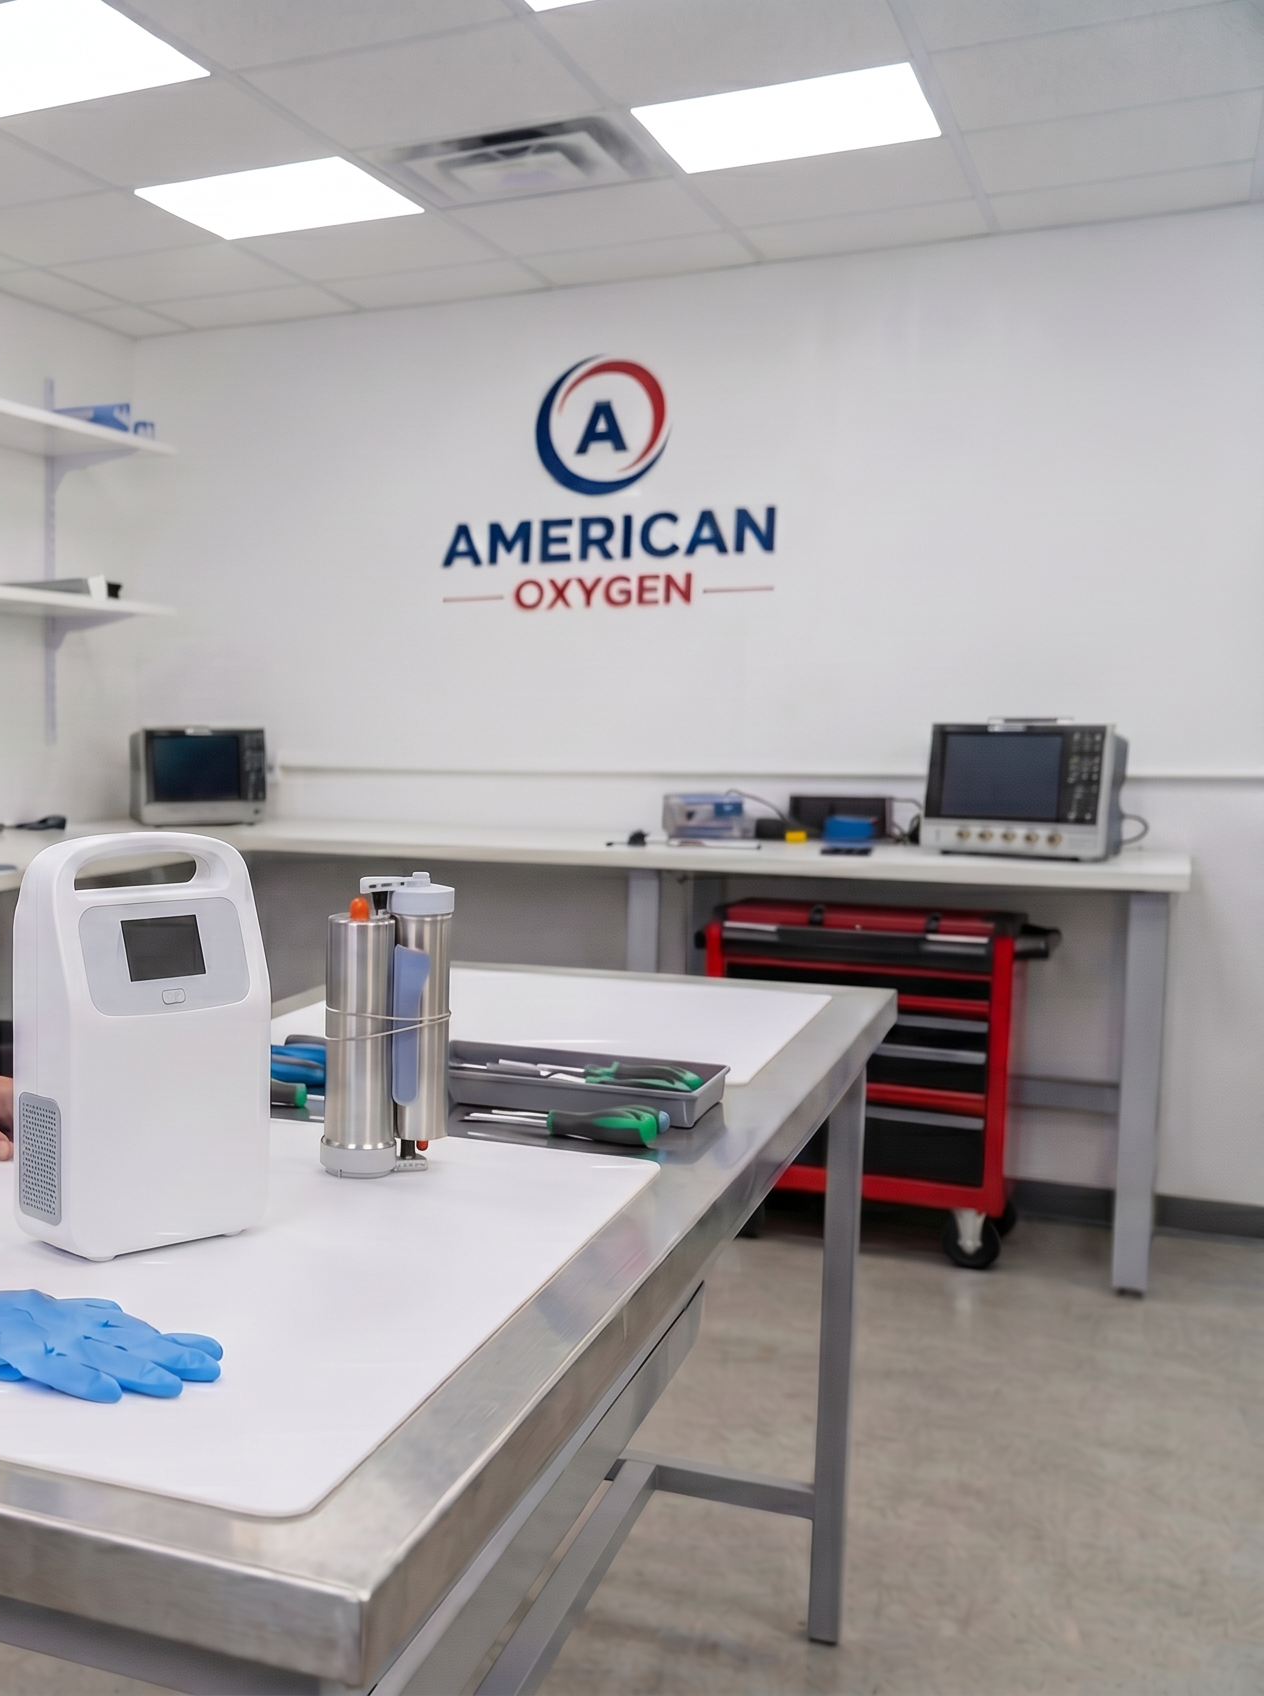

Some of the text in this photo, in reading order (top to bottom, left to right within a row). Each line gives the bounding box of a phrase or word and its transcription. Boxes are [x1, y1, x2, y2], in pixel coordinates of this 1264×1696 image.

[574, 400, 628, 455] A
[442, 506, 776, 568] AMERICAN
[513, 572, 693, 610] OXYGEN
